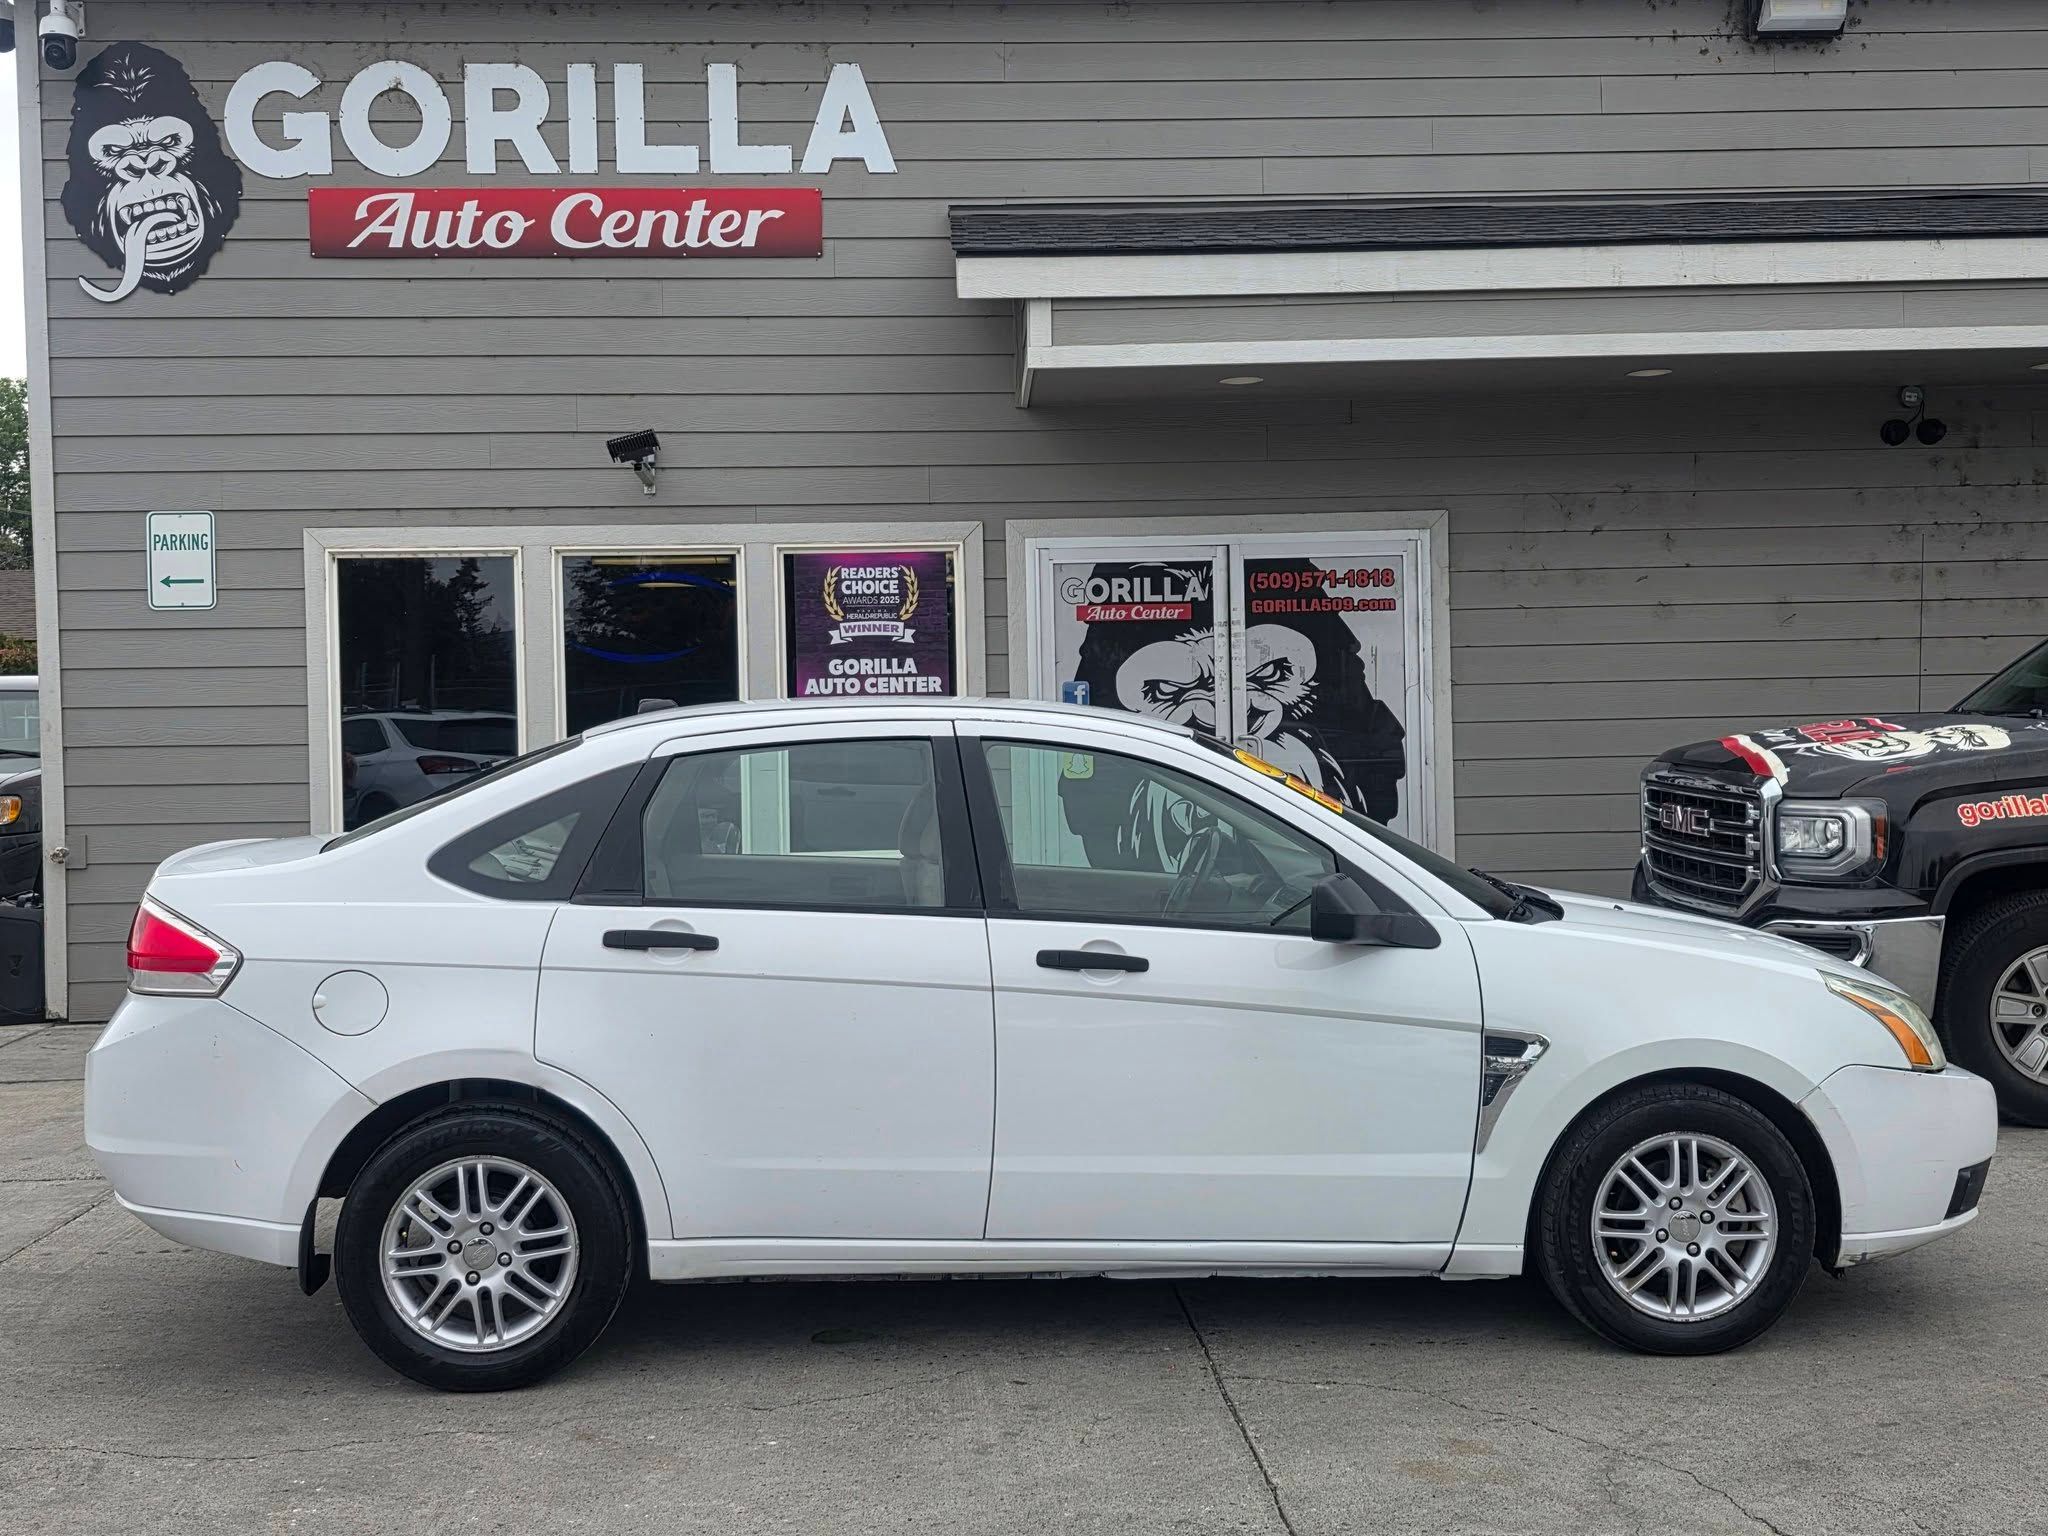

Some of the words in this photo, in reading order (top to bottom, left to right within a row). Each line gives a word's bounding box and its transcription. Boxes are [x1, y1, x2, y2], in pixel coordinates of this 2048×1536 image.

[223, 59, 899, 178] GORILLA
[347, 190, 537, 250] Auto
[550, 190, 785, 250] Center
[153, 533, 209, 551] PARKING
[840, 580, 900, 595] CHOICE
[1249, 567, 1396, 593] (509)571-1818
[1060, 576, 1206, 605] GORILLA
[842, 596, 878, 605] AWARDS
[1251, 596, 1397, 614] GORILLA509.com
[1086, 605, 1128, 620] Auto
[1130, 604, 1184, 620] Center
[842, 623, 900, 634] WINNER
[828, 657, 918, 676] GORILLA
[804, 676, 861, 695] AUTO
[864, 675, 943, 694] CENTER
[1660, 802, 1710, 838] GMC
